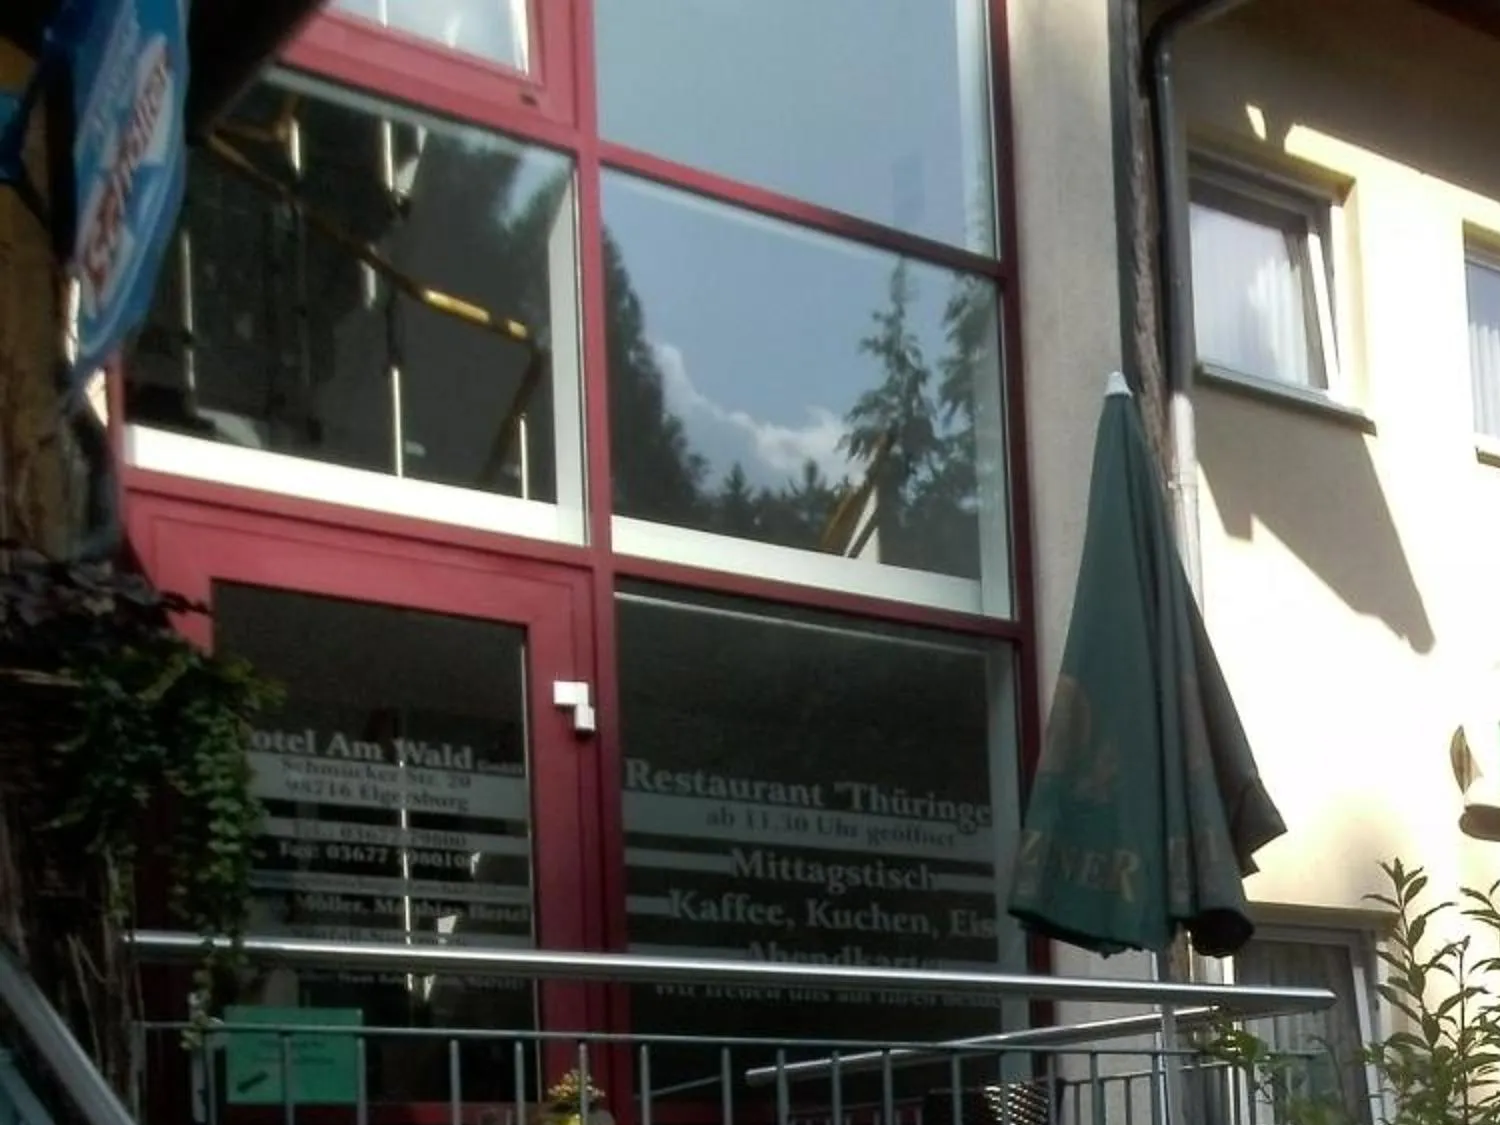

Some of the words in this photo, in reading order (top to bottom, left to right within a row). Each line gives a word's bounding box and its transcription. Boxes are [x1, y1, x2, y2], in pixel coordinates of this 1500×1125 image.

[248, 729, 317, 755] otel
[326, 731, 384, 760] Am
[392, 738, 473, 769] Wald
[625, 757, 824, 808] Restaurant
[731, 847, 938, 895] Mittagstisch
[668, 887, 796, 931] Kaffee,
[805, 898, 940, 939] Kuchen,
